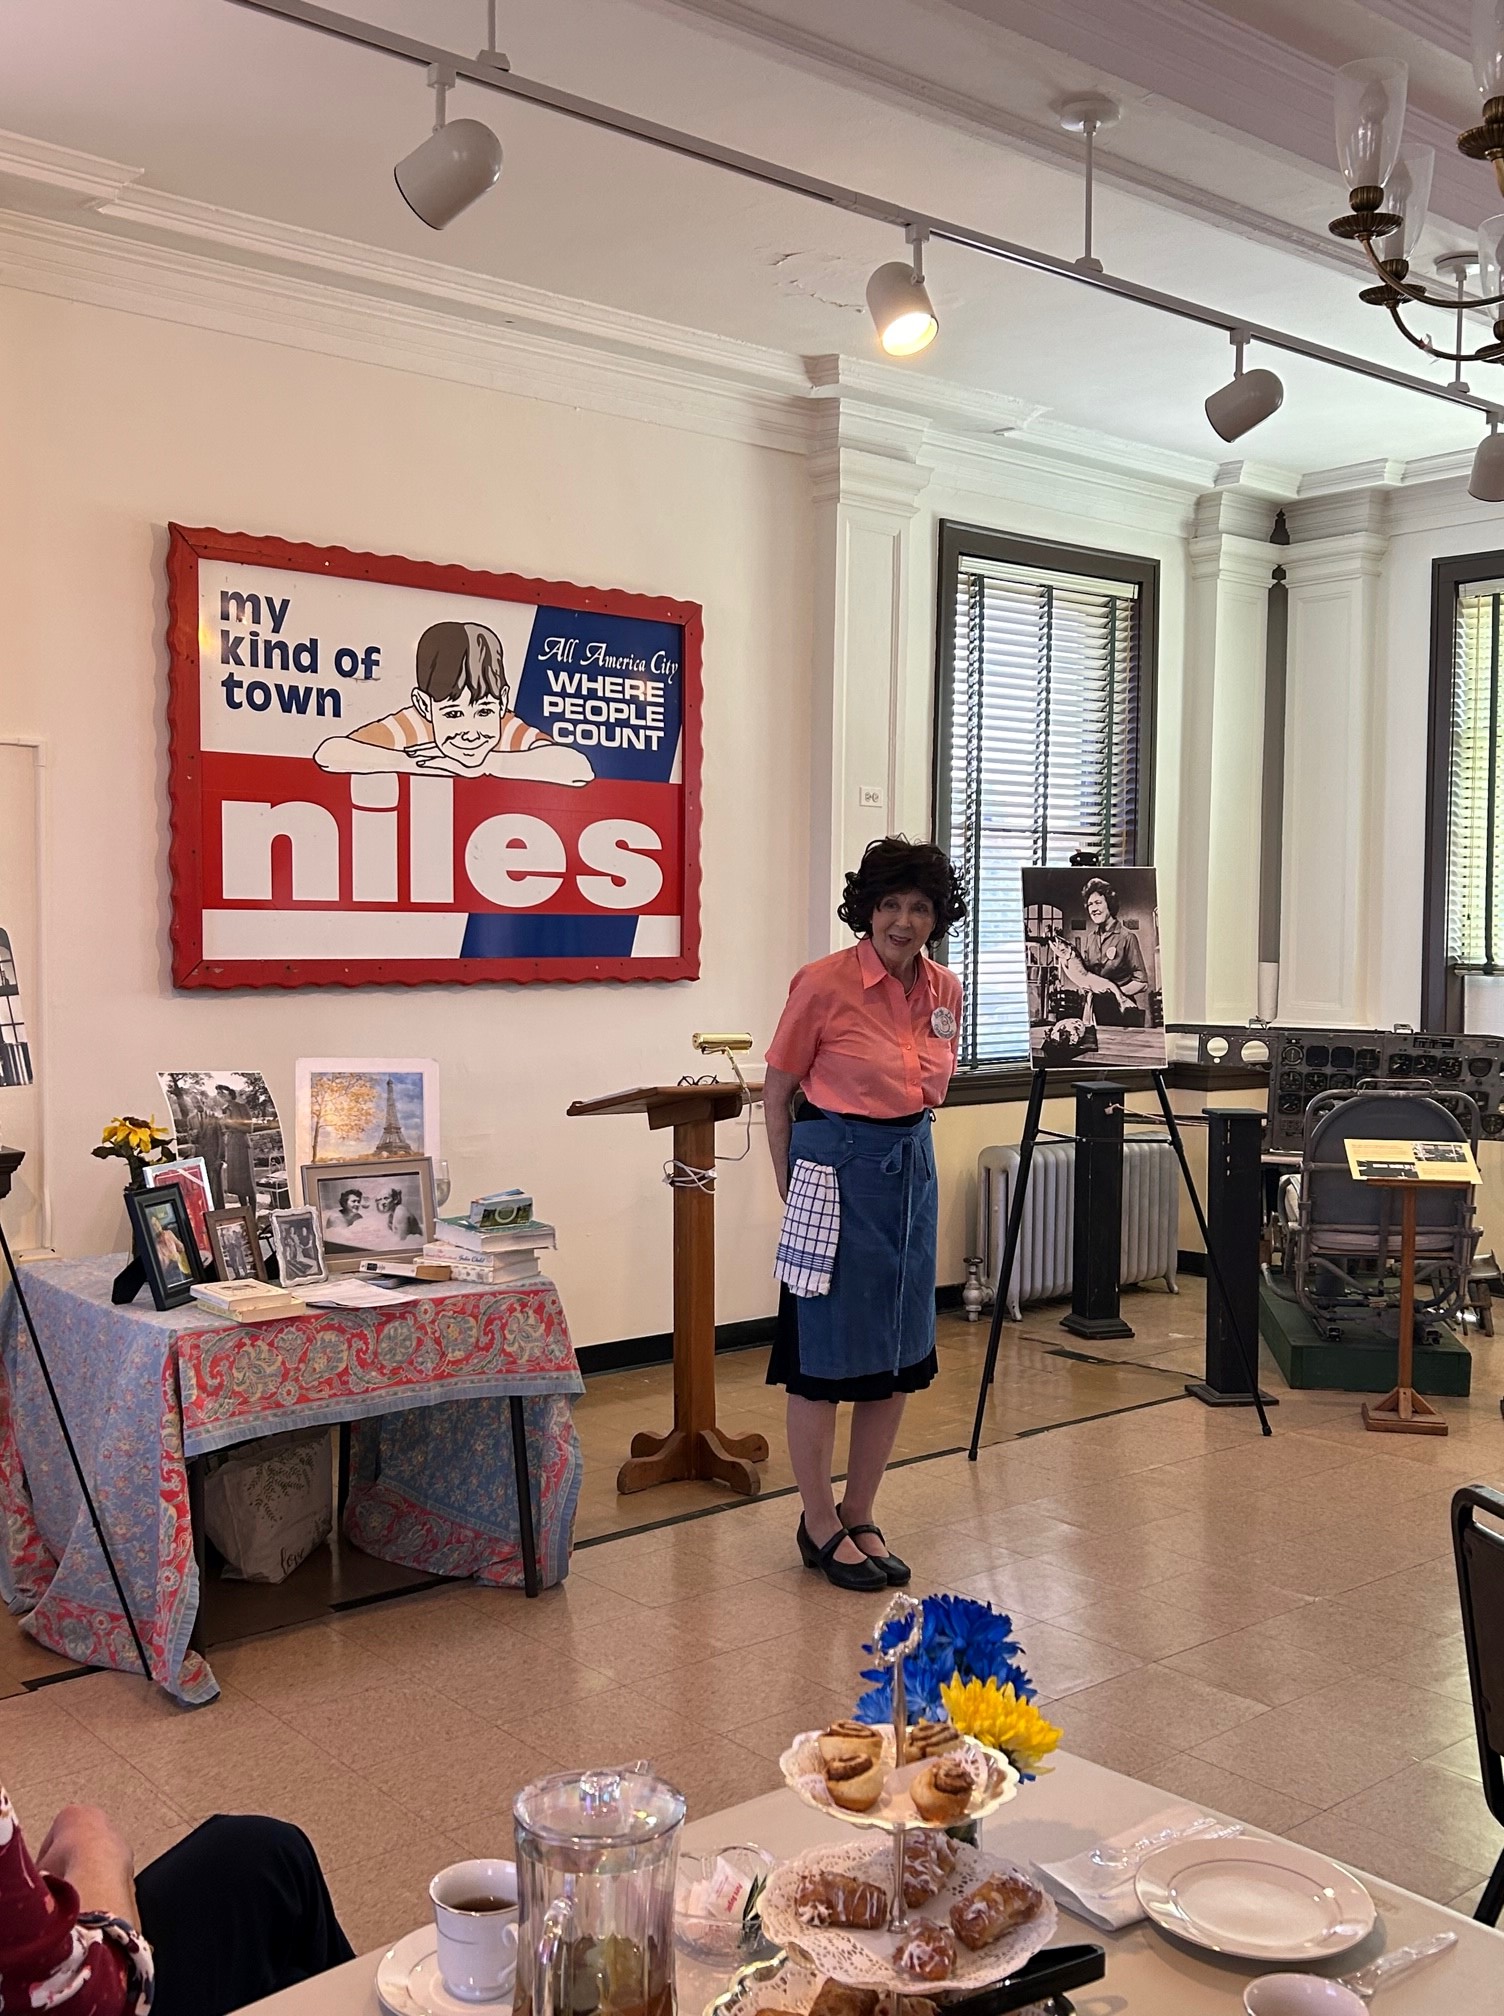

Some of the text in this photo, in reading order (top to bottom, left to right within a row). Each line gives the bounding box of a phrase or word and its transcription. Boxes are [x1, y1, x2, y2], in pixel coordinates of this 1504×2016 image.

[220, 590, 291, 634] my
[220, 629, 381, 680] kind of
[537, 637, 679, 685] All America City
[221, 672, 342, 718] town
[546, 669, 665, 703] WHERE
[543, 695, 665, 728] PEOPLE
[552, 721, 665, 751] COUNT
[221, 774, 664, 909] niles
